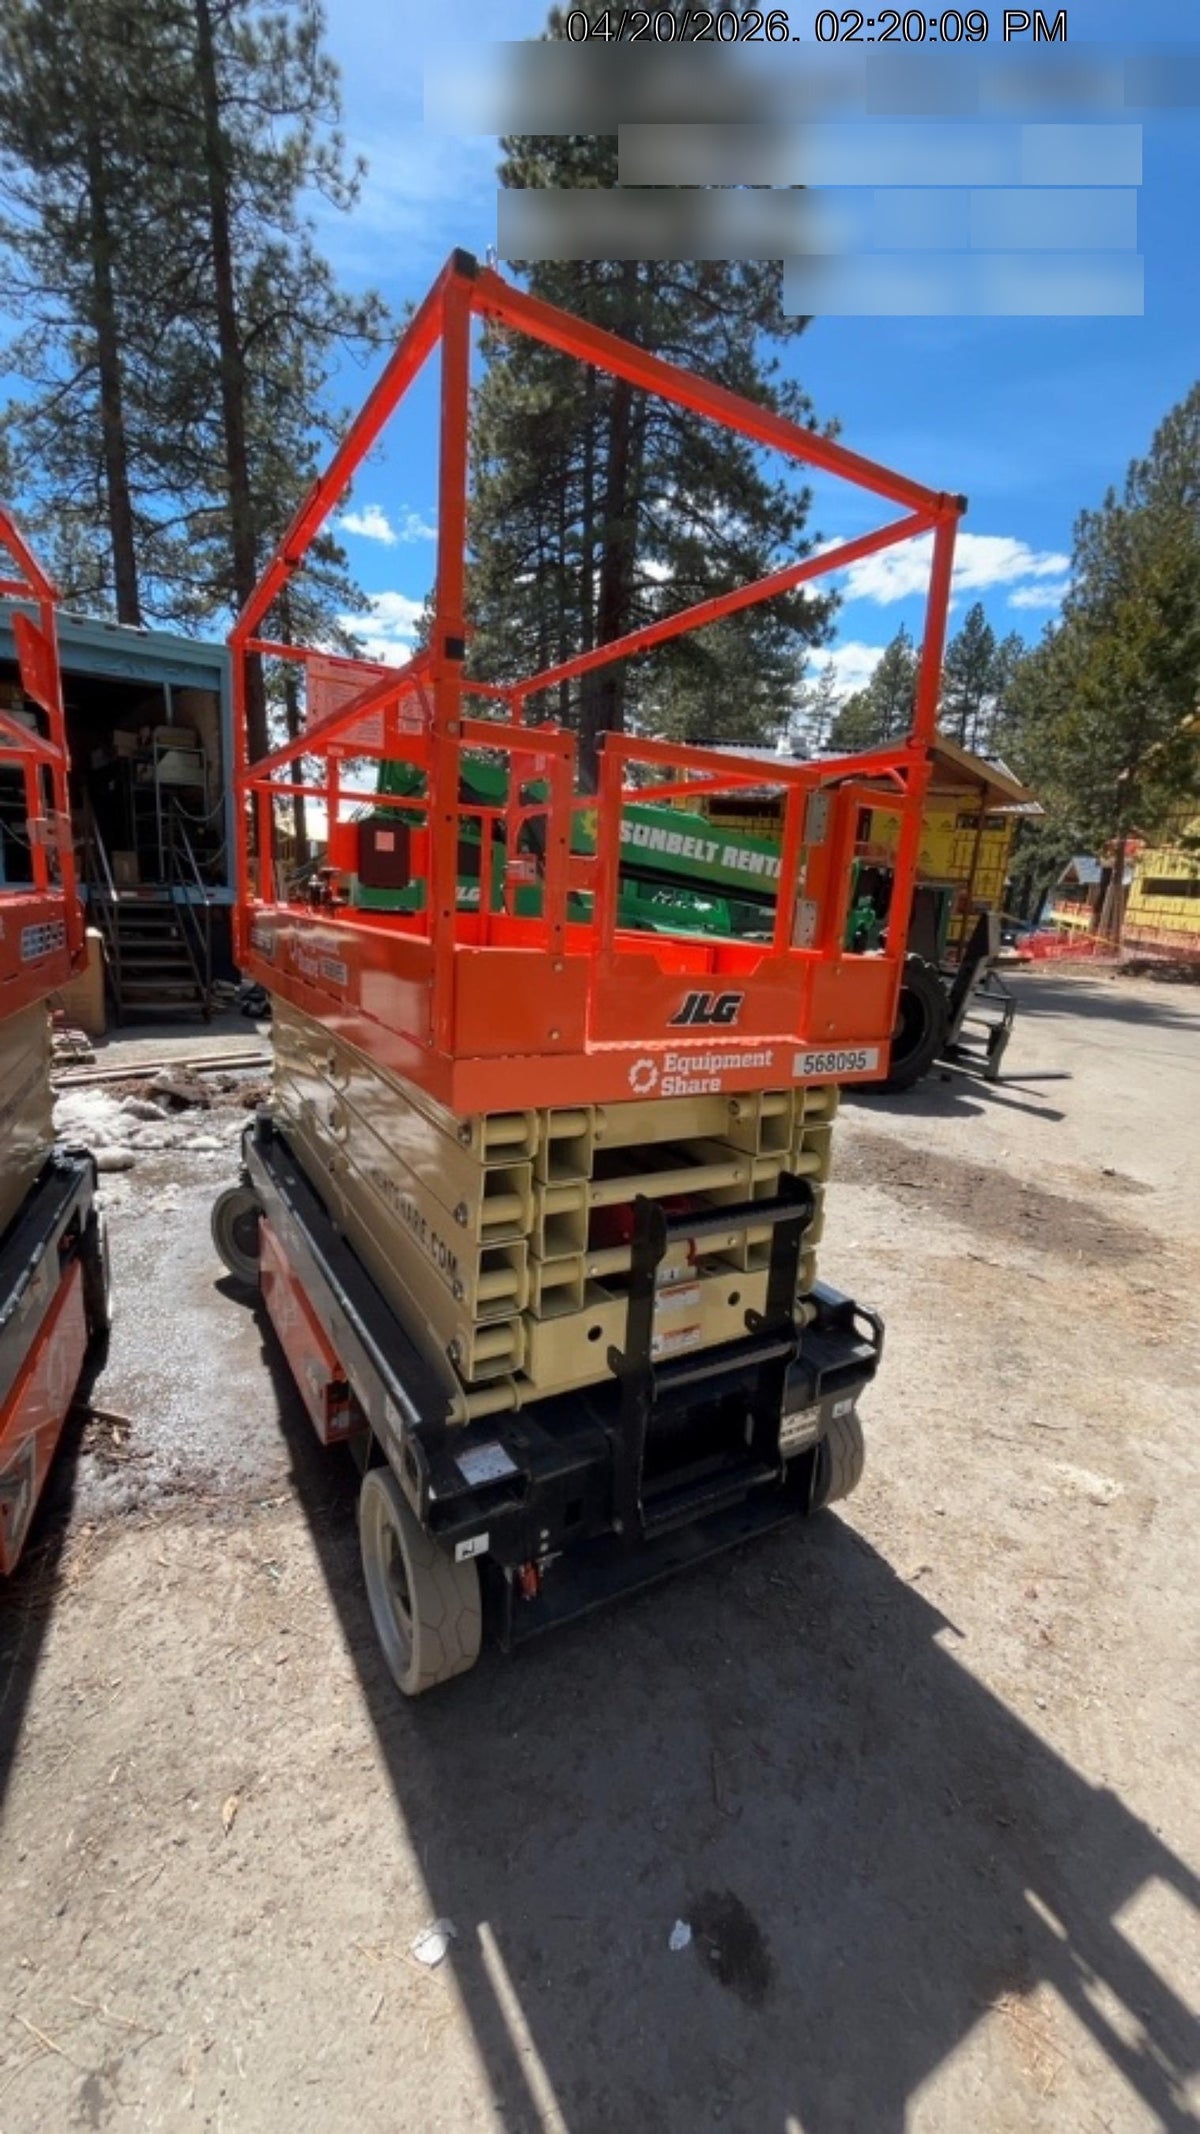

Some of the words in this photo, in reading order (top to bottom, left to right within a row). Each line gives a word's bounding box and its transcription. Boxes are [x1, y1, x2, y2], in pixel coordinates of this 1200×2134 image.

[619, 820, 719, 862] SUNBELT
[667, 991, 744, 1026] JLG
[663, 1049, 774, 1076] Equipment
[803, 1051, 867, 1075] 568095
[660, 1075, 722, 1097] Share
